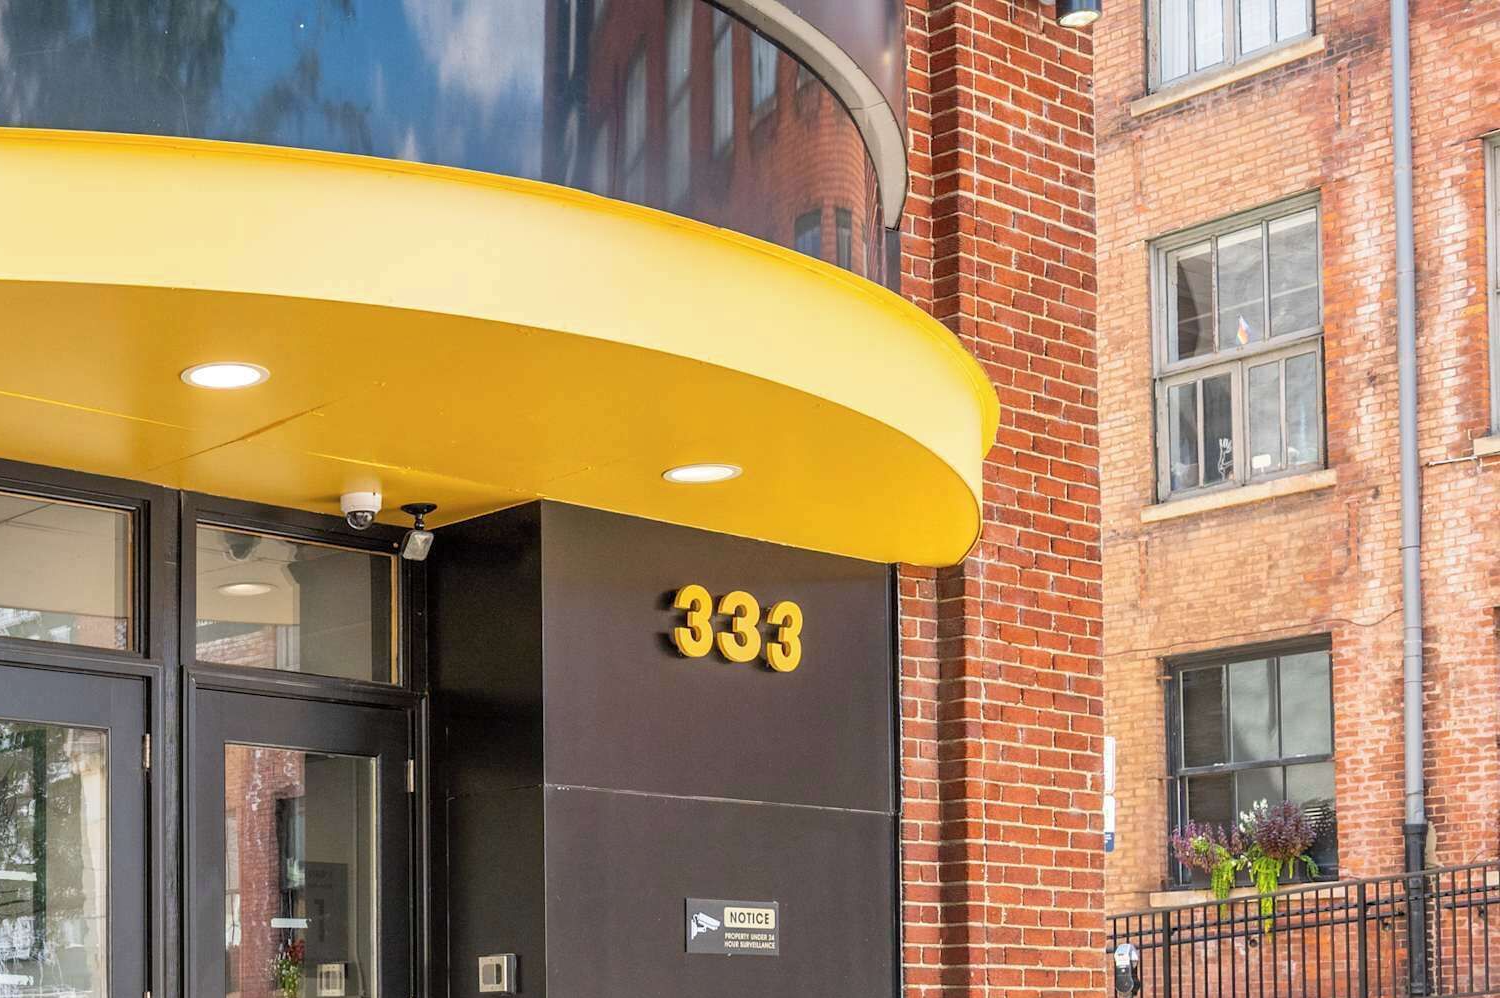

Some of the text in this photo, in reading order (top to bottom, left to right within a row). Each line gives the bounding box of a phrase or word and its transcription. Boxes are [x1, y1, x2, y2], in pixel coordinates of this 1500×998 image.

[674, 584, 803, 672] 333
[730, 911, 770, 925] NOTICE
[724, 932, 750, 941] PROPERTY
[751, 933, 767, 941] UNDER
[724, 941, 776, 950] HOUR SURVEILLANCE
